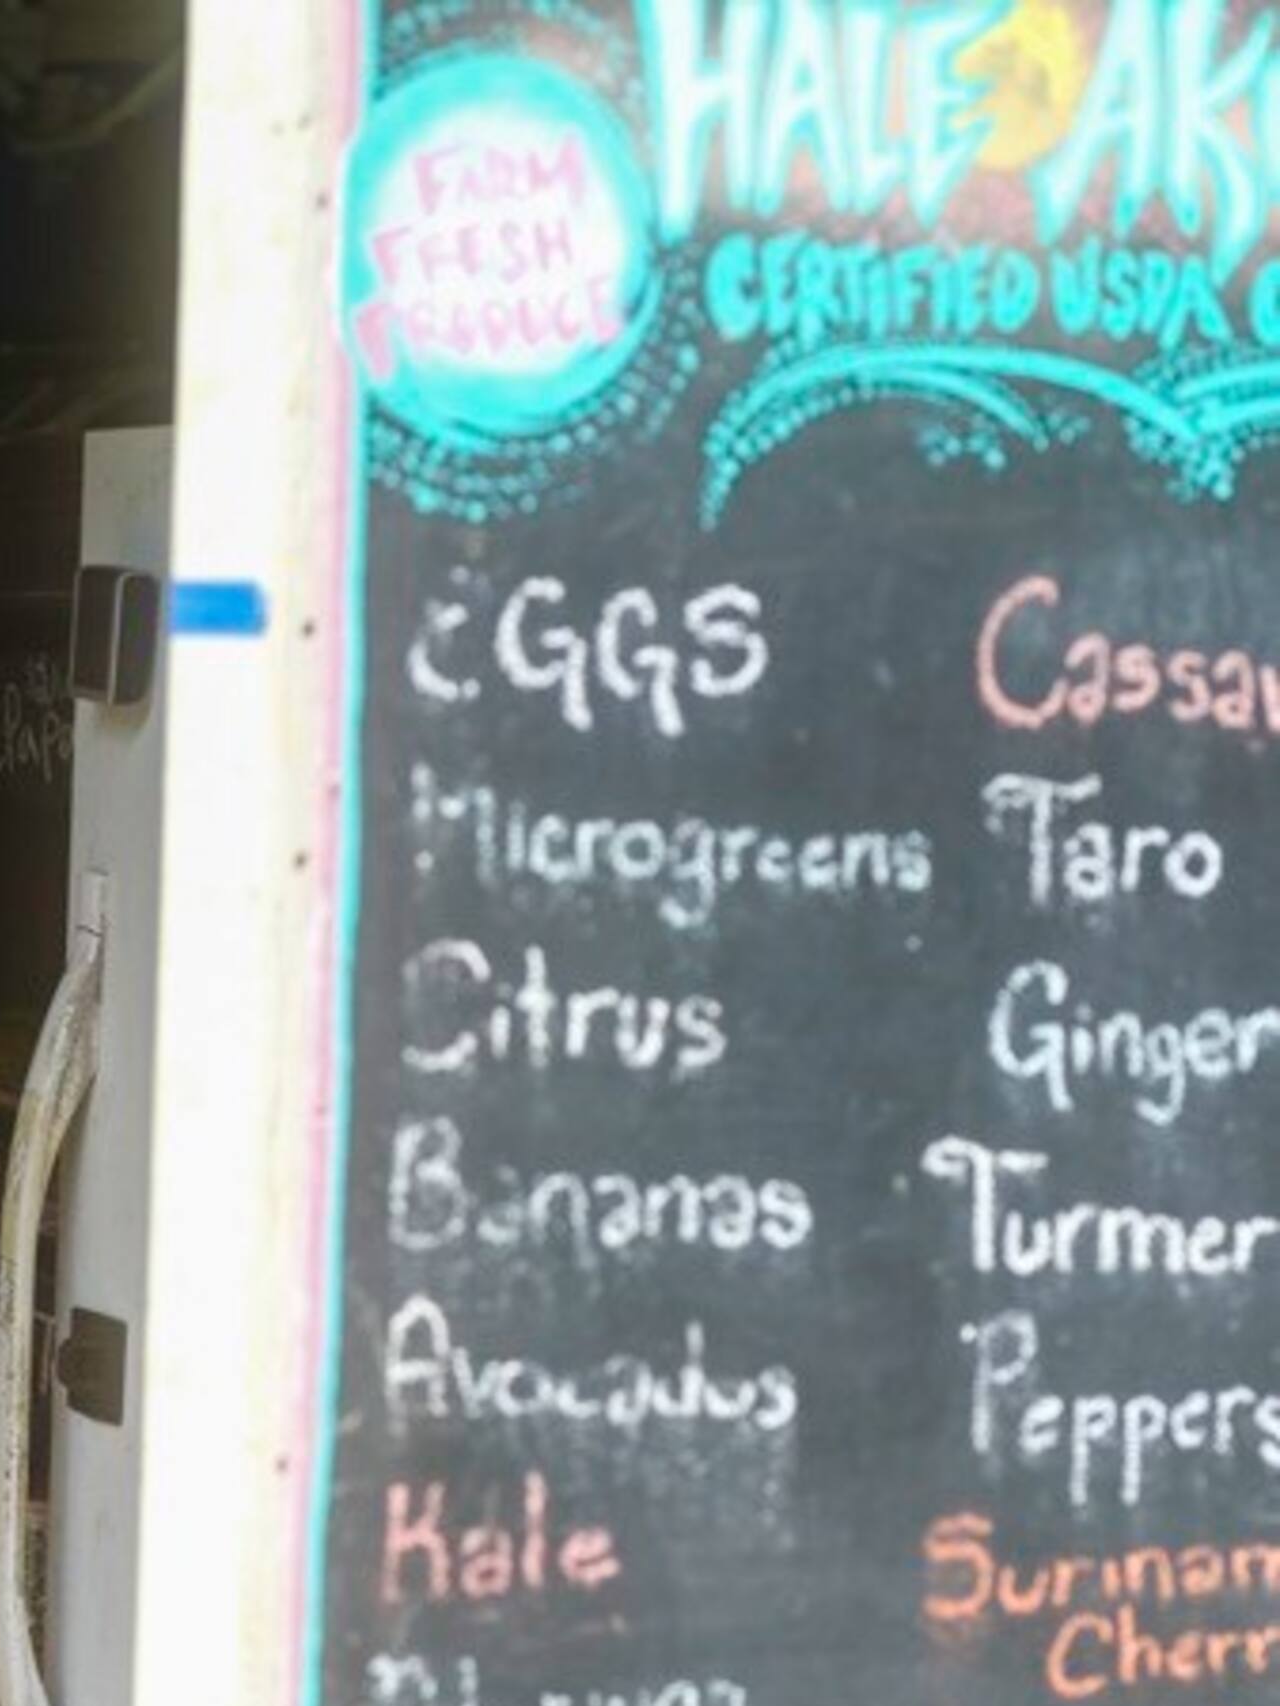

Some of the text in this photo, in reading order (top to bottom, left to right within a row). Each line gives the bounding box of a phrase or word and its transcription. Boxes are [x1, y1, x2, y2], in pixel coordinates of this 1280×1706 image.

[640, 0, 1280, 285] HALE AK
[706, 230, 1038, 348] CERTIFIED
[980, 772, 1224, 905] Taro
[402, 936, 727, 1072] Citrus
[990, 959, 1280, 1126] Ginger
[922, 1135, 1280, 1276] Turmer
[960, 1310, 1280, 1506] Peppers
[383, 1472, 621, 1600] Kale
